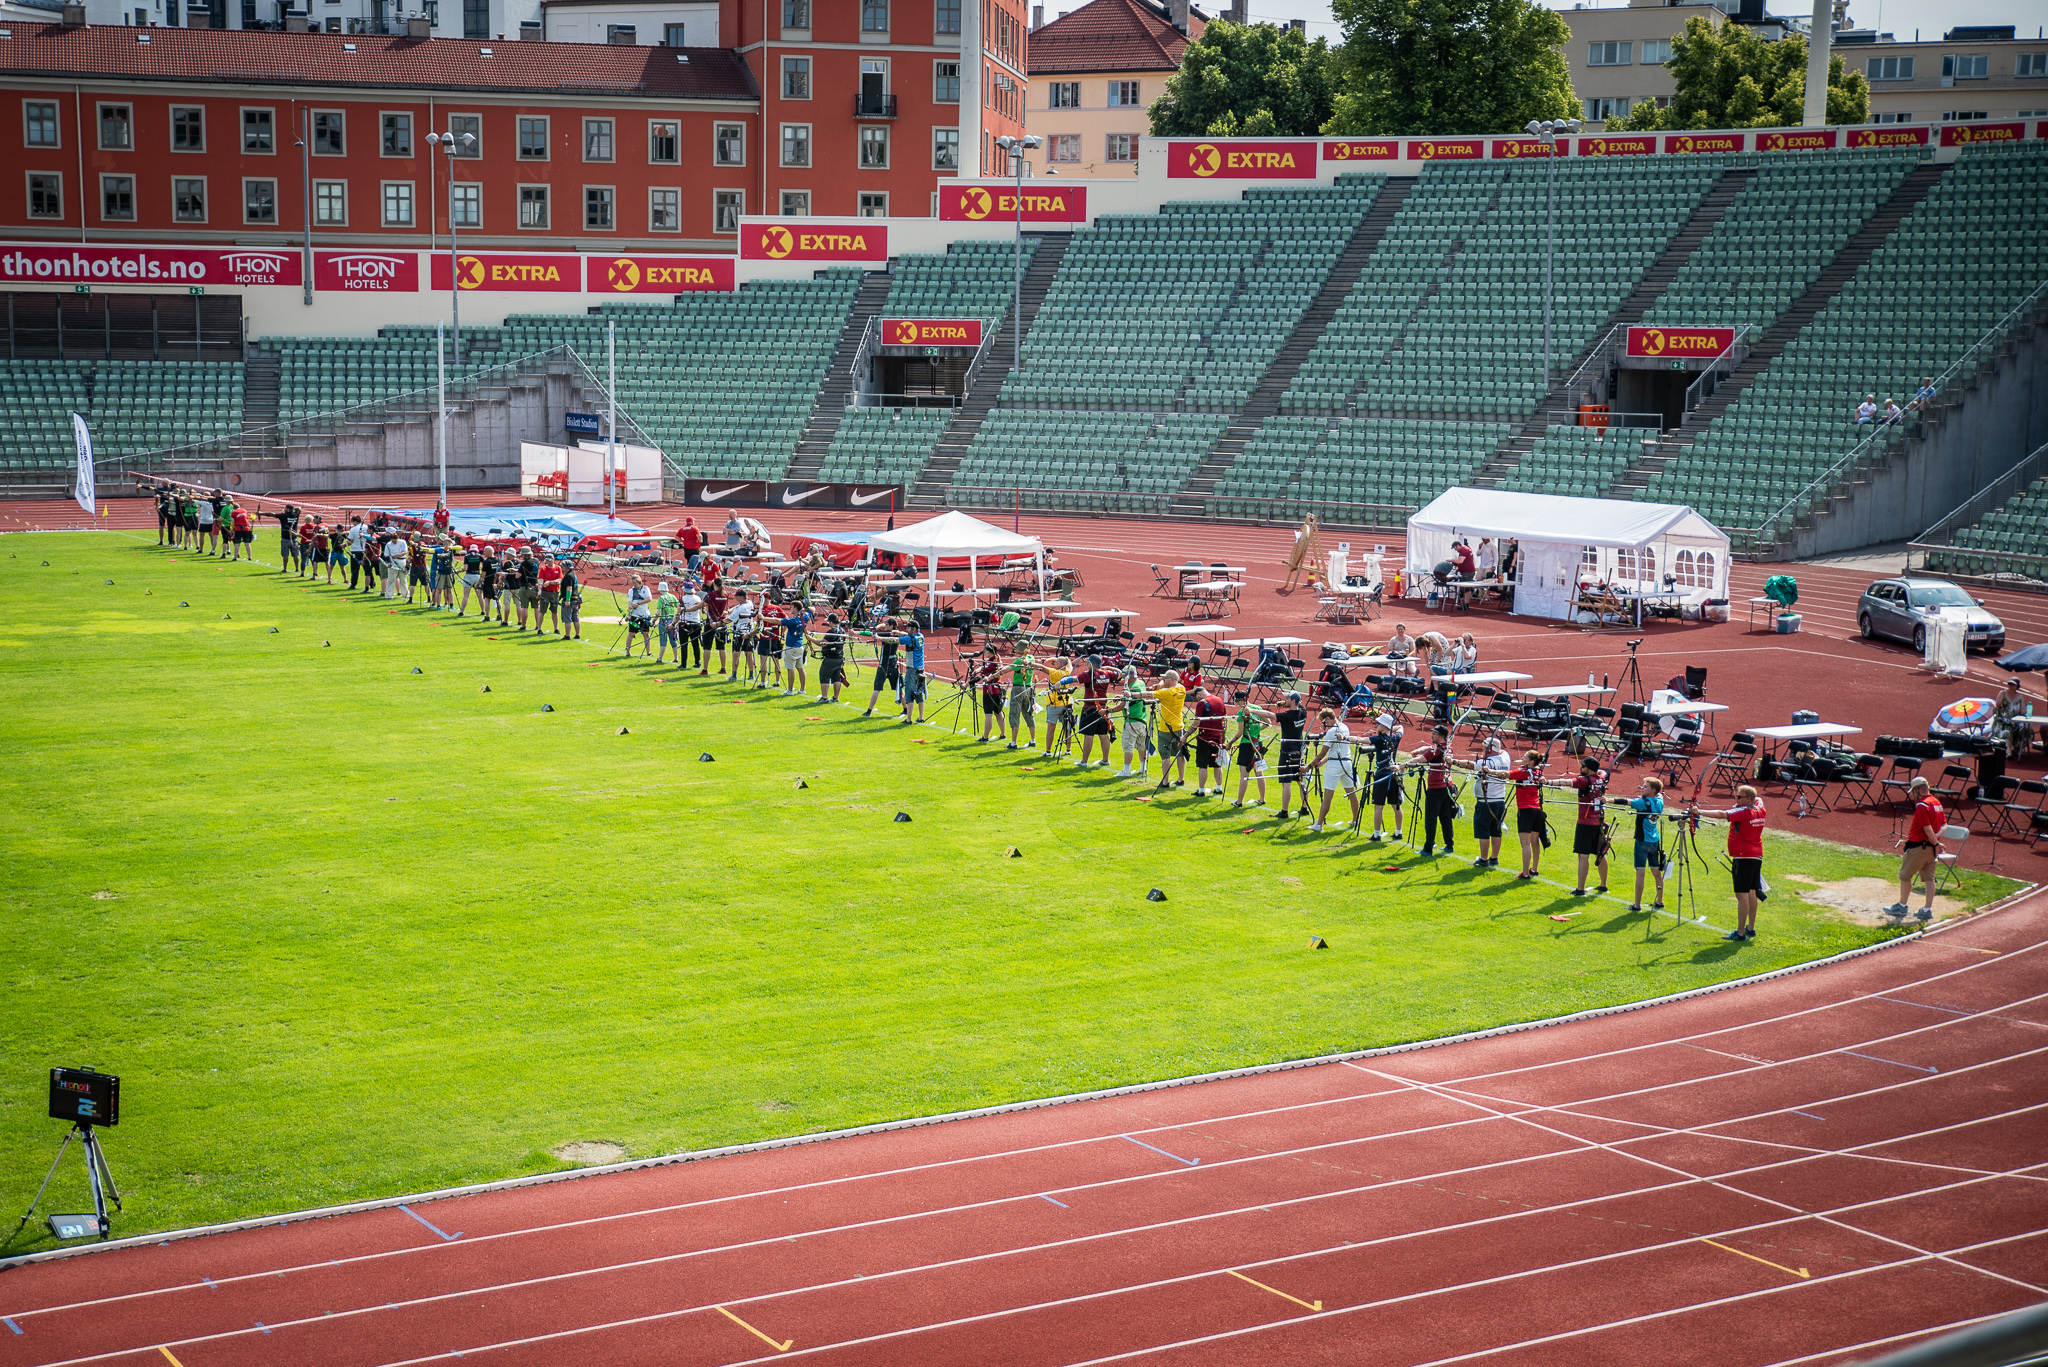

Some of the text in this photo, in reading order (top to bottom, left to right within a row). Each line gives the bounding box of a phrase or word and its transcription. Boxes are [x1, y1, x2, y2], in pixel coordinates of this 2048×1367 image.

[1880, 133, 1918, 143] EXTRA
[1974, 129, 2013, 139] EXTRA
[1609, 141, 1646, 151] EXTRA
[1696, 140, 1733, 149] EXTRA
[1788, 137, 1825, 147] EXTRA
[1353, 146, 1389, 155] EXTRA
[1437, 145, 1473, 155] EXTRA
[1522, 144, 1559, 153] EXTRA
[1228, 152, 1296, 168] EXTRA
[999, 195, 1066, 212] EXTRA
[800, 234, 868, 251] EXTRA
[2, 251, 207, 279] thonhotels.no
[219, 252, 289, 273] THON
[328, 254, 405, 277] THON
[235, 274, 275, 283] HOTELS
[492, 265, 561, 282] EXTRA
[647, 268, 715, 284] EXTRA
[345, 279, 389, 289] HOTELS
[921, 326, 968, 339] EXTRA
[1669, 336, 1719, 349] EXTRA
[581, 417, 598, 429] Stadion
